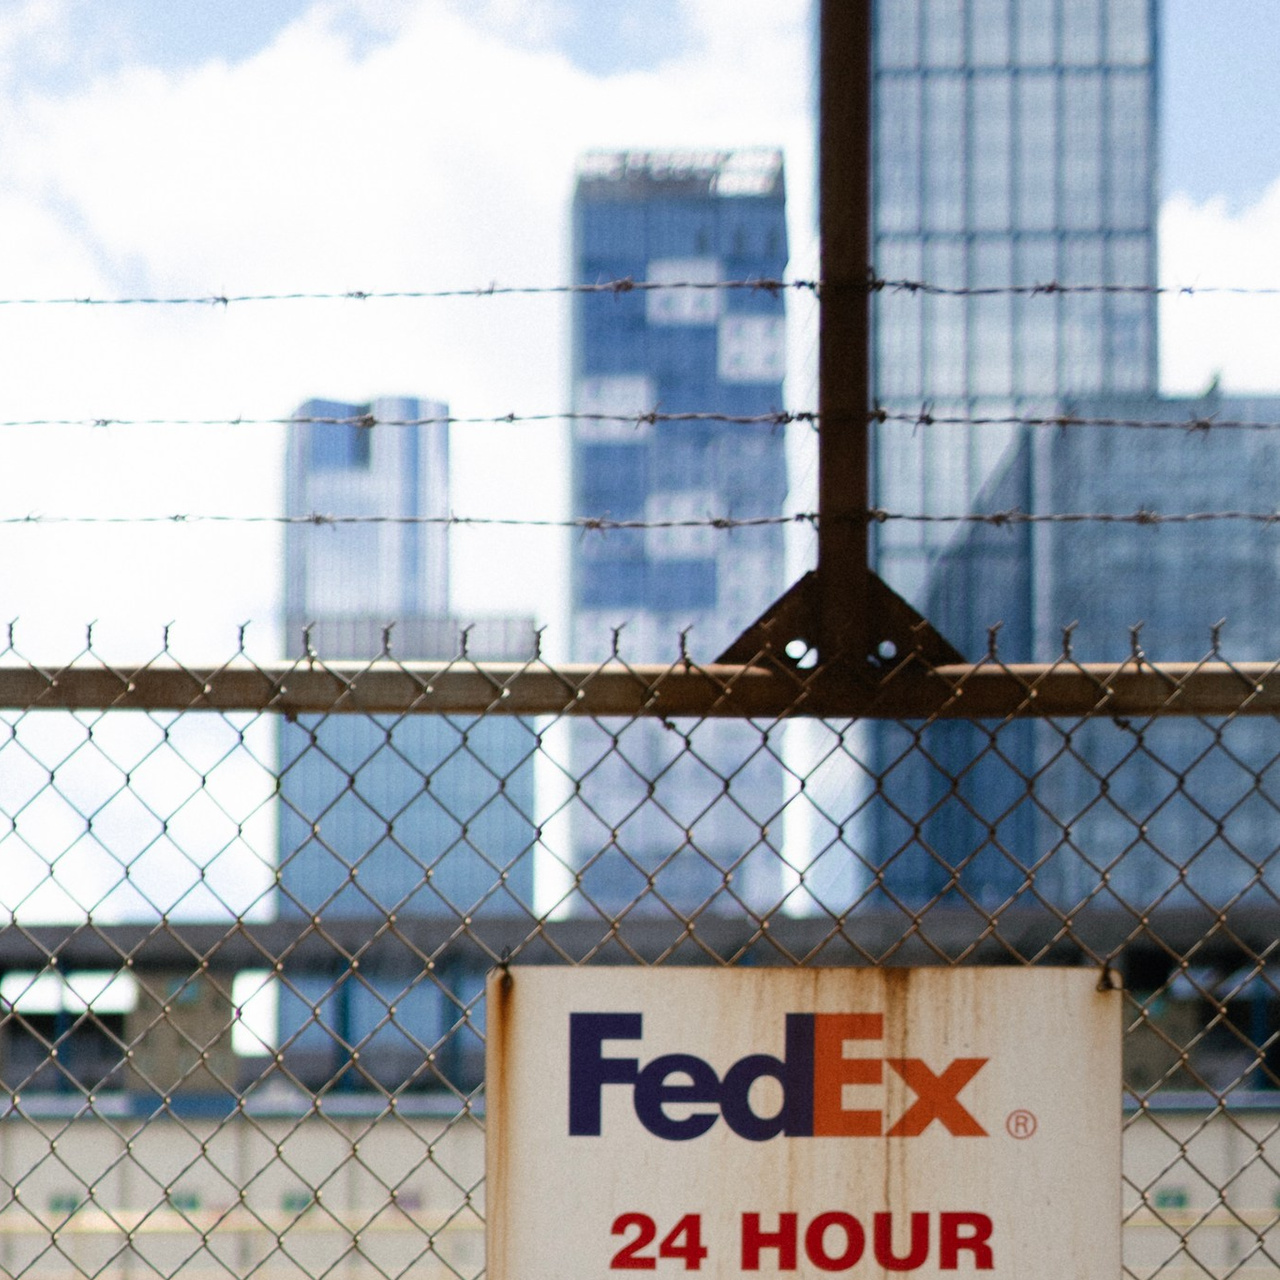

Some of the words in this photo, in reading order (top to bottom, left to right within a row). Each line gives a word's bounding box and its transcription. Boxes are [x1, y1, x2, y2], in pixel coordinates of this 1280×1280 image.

[568, 1012, 991, 1142] FedEx
[610, 1212, 708, 1270] 24
[740, 1211, 994, 1272] HOUR
